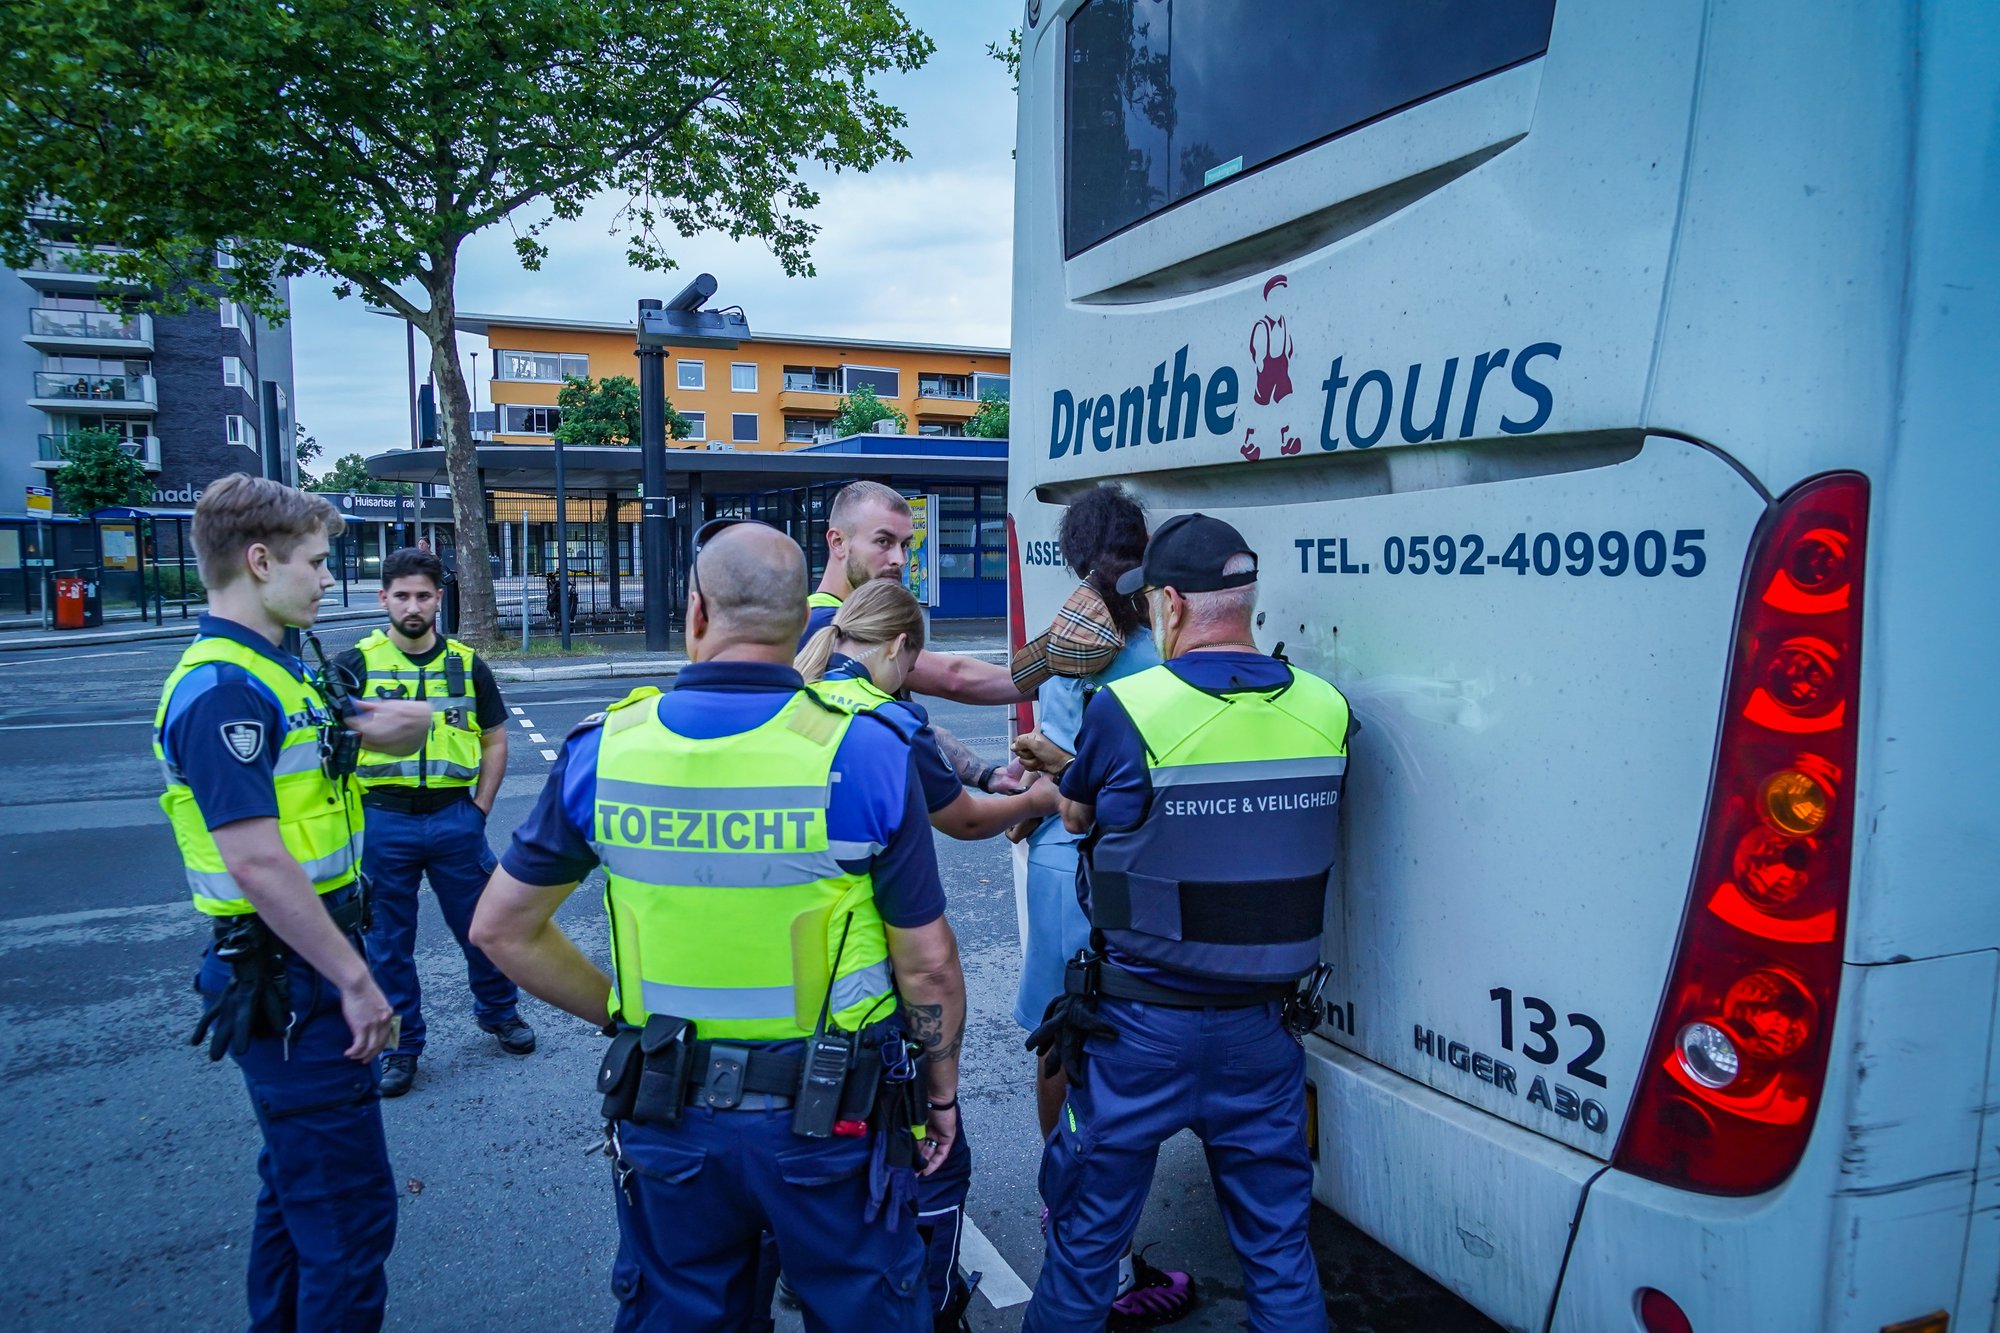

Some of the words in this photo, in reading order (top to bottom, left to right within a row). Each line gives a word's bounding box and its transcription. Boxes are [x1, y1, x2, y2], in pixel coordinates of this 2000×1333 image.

[1049, 343, 1239, 460] Drenthe
[1320, 341, 1563, 452] tours
[1025, 541, 1066, 567] ASSE
[1294, 537, 1370, 575] TEL.
[1383, 528, 1707, 577] 0592-409905
[598, 803, 815, 850] TOEZICHT
[1165, 798, 1237, 816] SERVICE
[1242, 797, 1254, 813] &
[1257, 790, 1338, 812] VEILIGHEID
[1489, 986, 1608, 1090] 132
[1414, 1024, 1518, 1096] HIGER
[1526, 1074, 1609, 1135] A30
